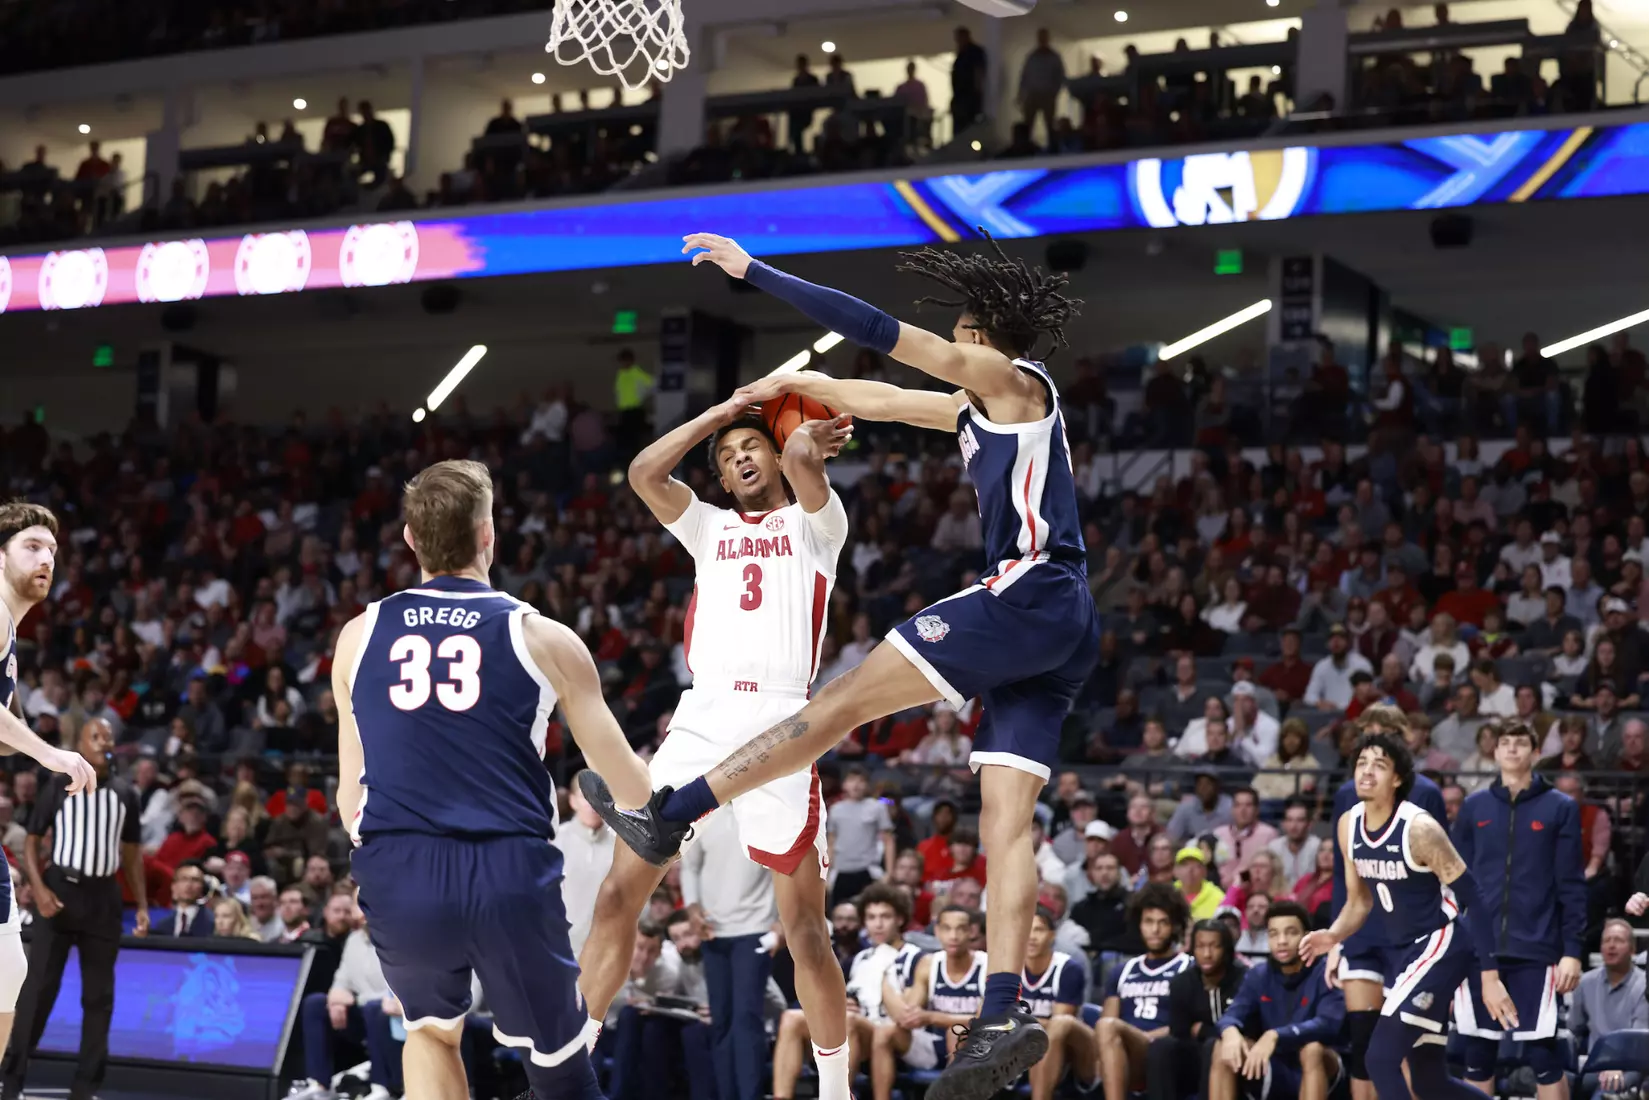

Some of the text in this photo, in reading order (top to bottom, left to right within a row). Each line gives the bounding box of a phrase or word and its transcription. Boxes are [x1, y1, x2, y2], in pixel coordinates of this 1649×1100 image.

[766, 516, 784, 531] SEC
[716, 534, 793, 561] ALABAMA
[739, 562, 763, 612] 3
[403, 606, 482, 629] GREGG
[388, 633, 482, 712] 33
[733, 680, 758, 692] RTR
[1376, 882, 1394, 913] 0
